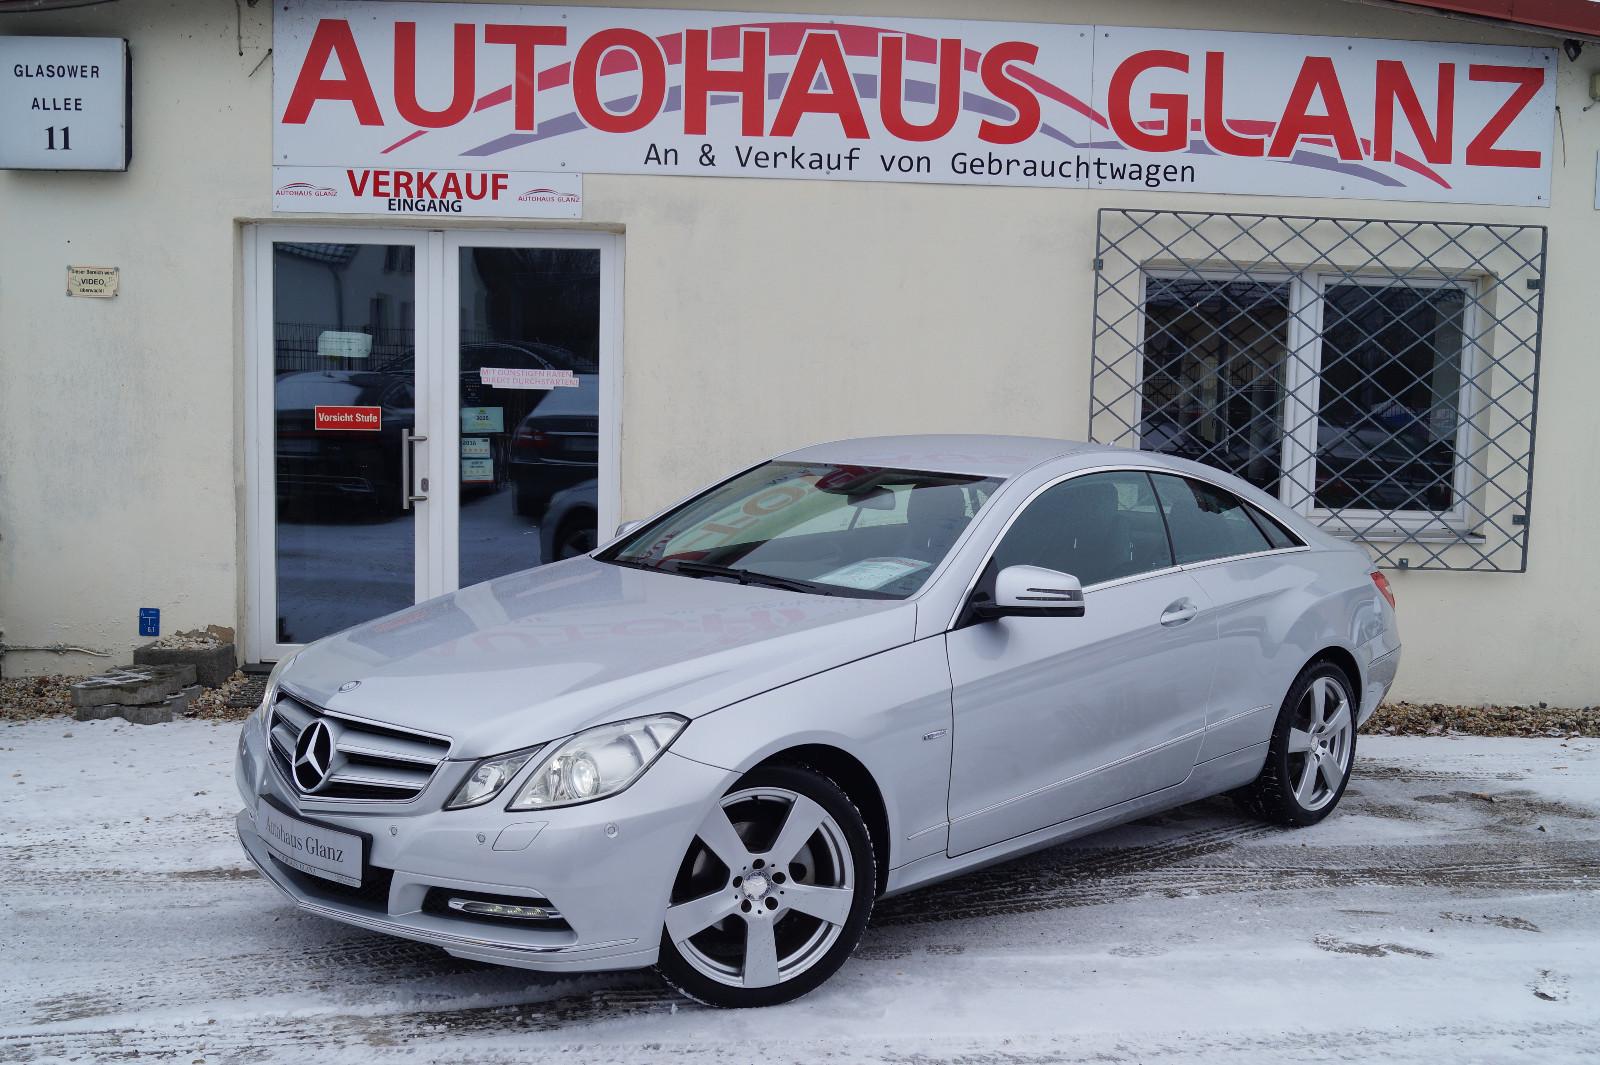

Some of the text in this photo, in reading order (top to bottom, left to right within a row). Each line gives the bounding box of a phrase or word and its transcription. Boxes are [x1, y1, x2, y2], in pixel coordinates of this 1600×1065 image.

[13, 64, 100, 78] GLASOWER
[282, 18, 1546, 168] AUTOHAUS GLANZ
[31, 97, 83, 111] ALLEE
[44, 126, 73, 151] 11
[643, 143, 1196, 187] An & Verkauf von Gebrauchtwagen
[346, 169, 509, 201] VERKAUF
[387, 198, 463, 213] EINGANG
[80, 278, 105, 286] VIDEO
[318, 412, 378, 423] Vorsicht Stufe
[265, 816, 344, 863] Autohaus Glanz
